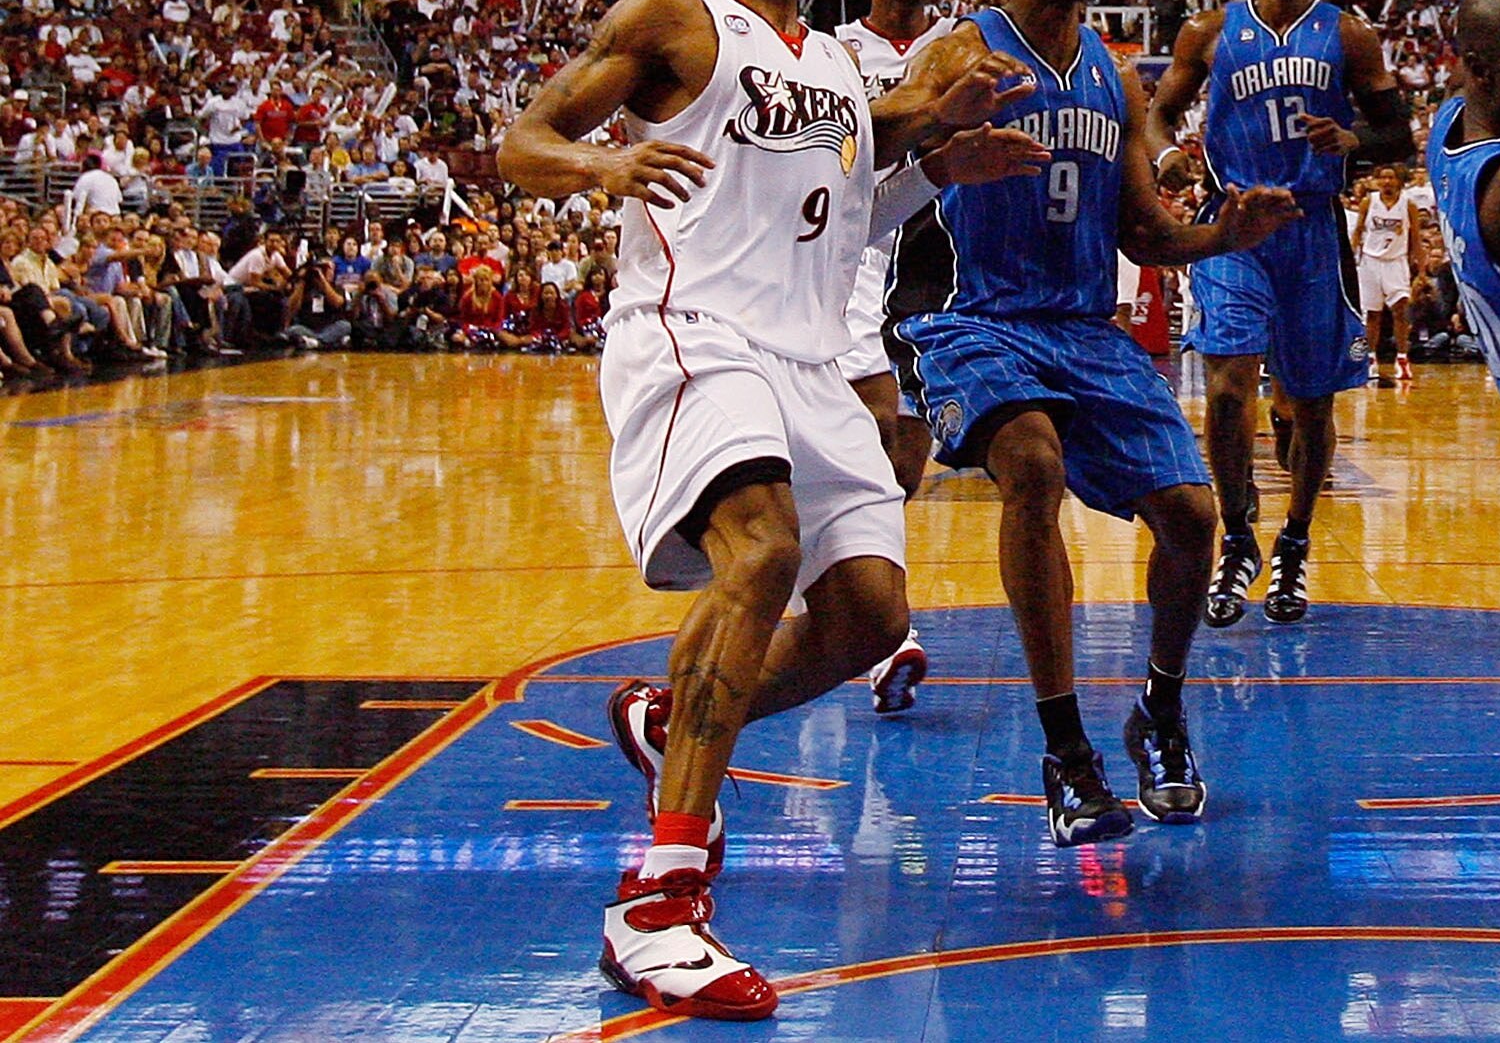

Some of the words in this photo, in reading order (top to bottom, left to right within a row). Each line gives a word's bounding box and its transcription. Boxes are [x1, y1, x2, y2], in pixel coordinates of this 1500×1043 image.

[723, 65, 859, 146] SIXERS
[1231, 56, 1331, 101] ORLANDO
[1264, 95, 1308, 142] 12
[796, 186, 831, 243] 9
[1046, 160, 1080, 224] 9
